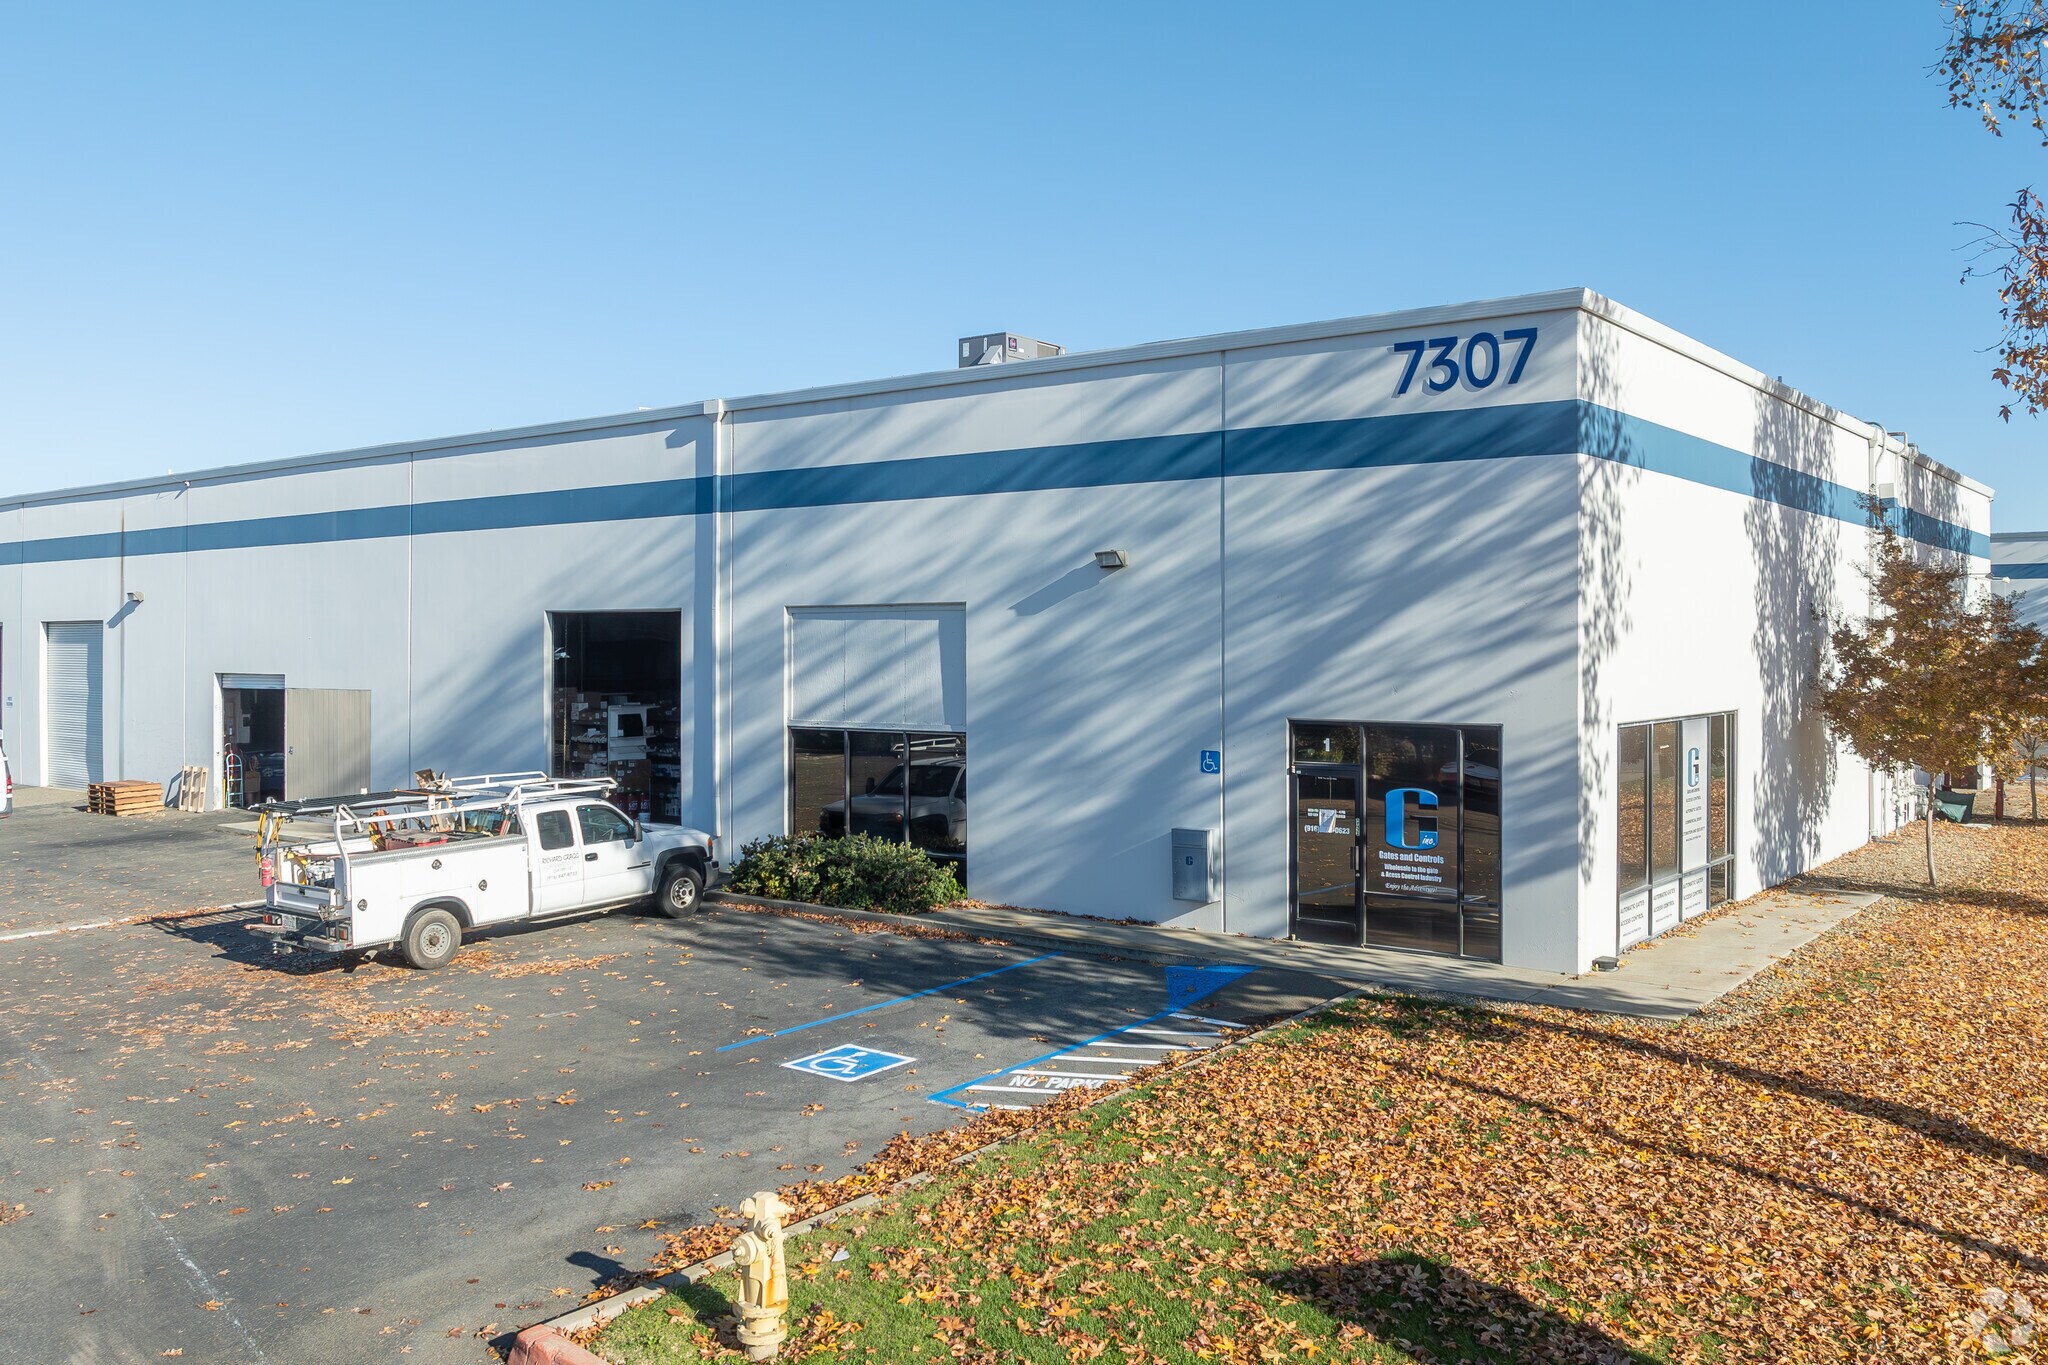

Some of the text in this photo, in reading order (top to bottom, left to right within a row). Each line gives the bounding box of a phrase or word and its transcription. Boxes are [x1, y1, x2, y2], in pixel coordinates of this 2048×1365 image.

[1393, 327, 1538, 395] 7307
[1323, 737, 1330, 752] 1
[1378, 850, 1445, 864] Gates and Controls
[1383, 863, 1412, 872] Wholesale
[1417, 865, 1427, 873] the
[1401, 872, 1420, 881] Control
[1420, 874, 1443, 883] Industry
[1008, 1075, 1040, 1087] NO
